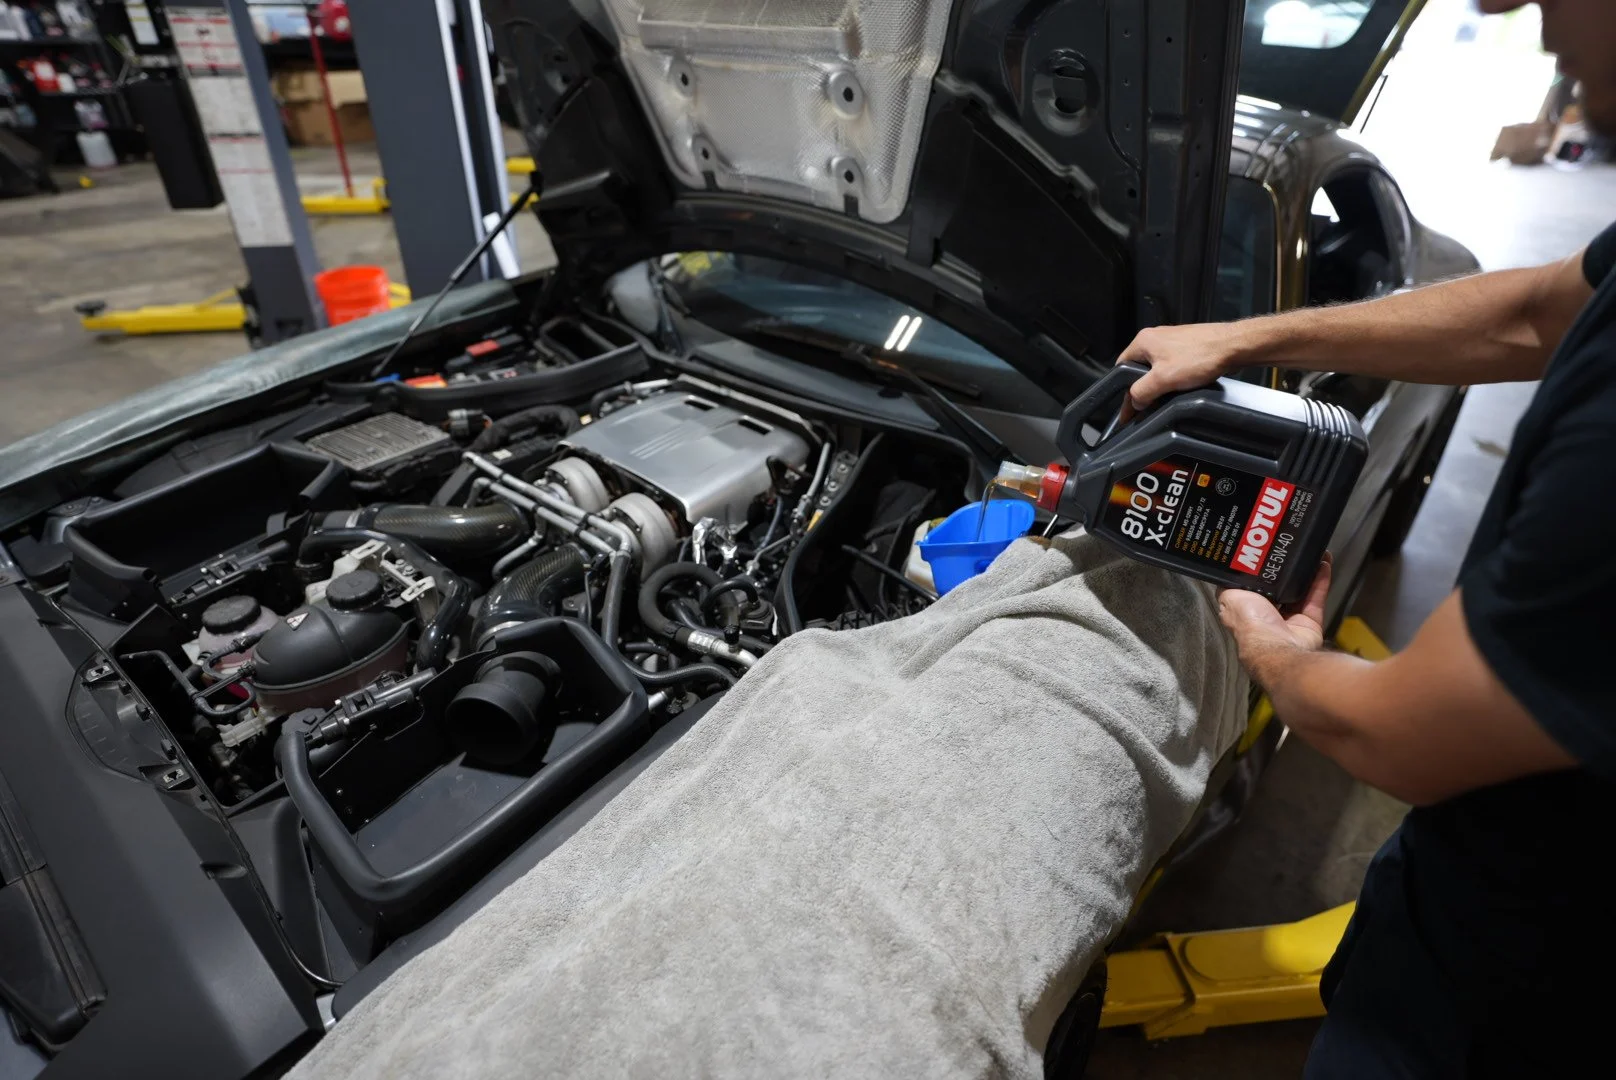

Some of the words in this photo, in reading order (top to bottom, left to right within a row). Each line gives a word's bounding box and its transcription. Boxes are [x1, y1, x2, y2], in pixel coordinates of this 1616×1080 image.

[1121, 473, 1159, 538] 8100
[1145, 470, 1188, 545] X-clean
[1238, 487, 1288, 570] MOTUL
[1263, 563, 1281, 580] SAE
[1270, 533, 1293, 563] 5W-40
